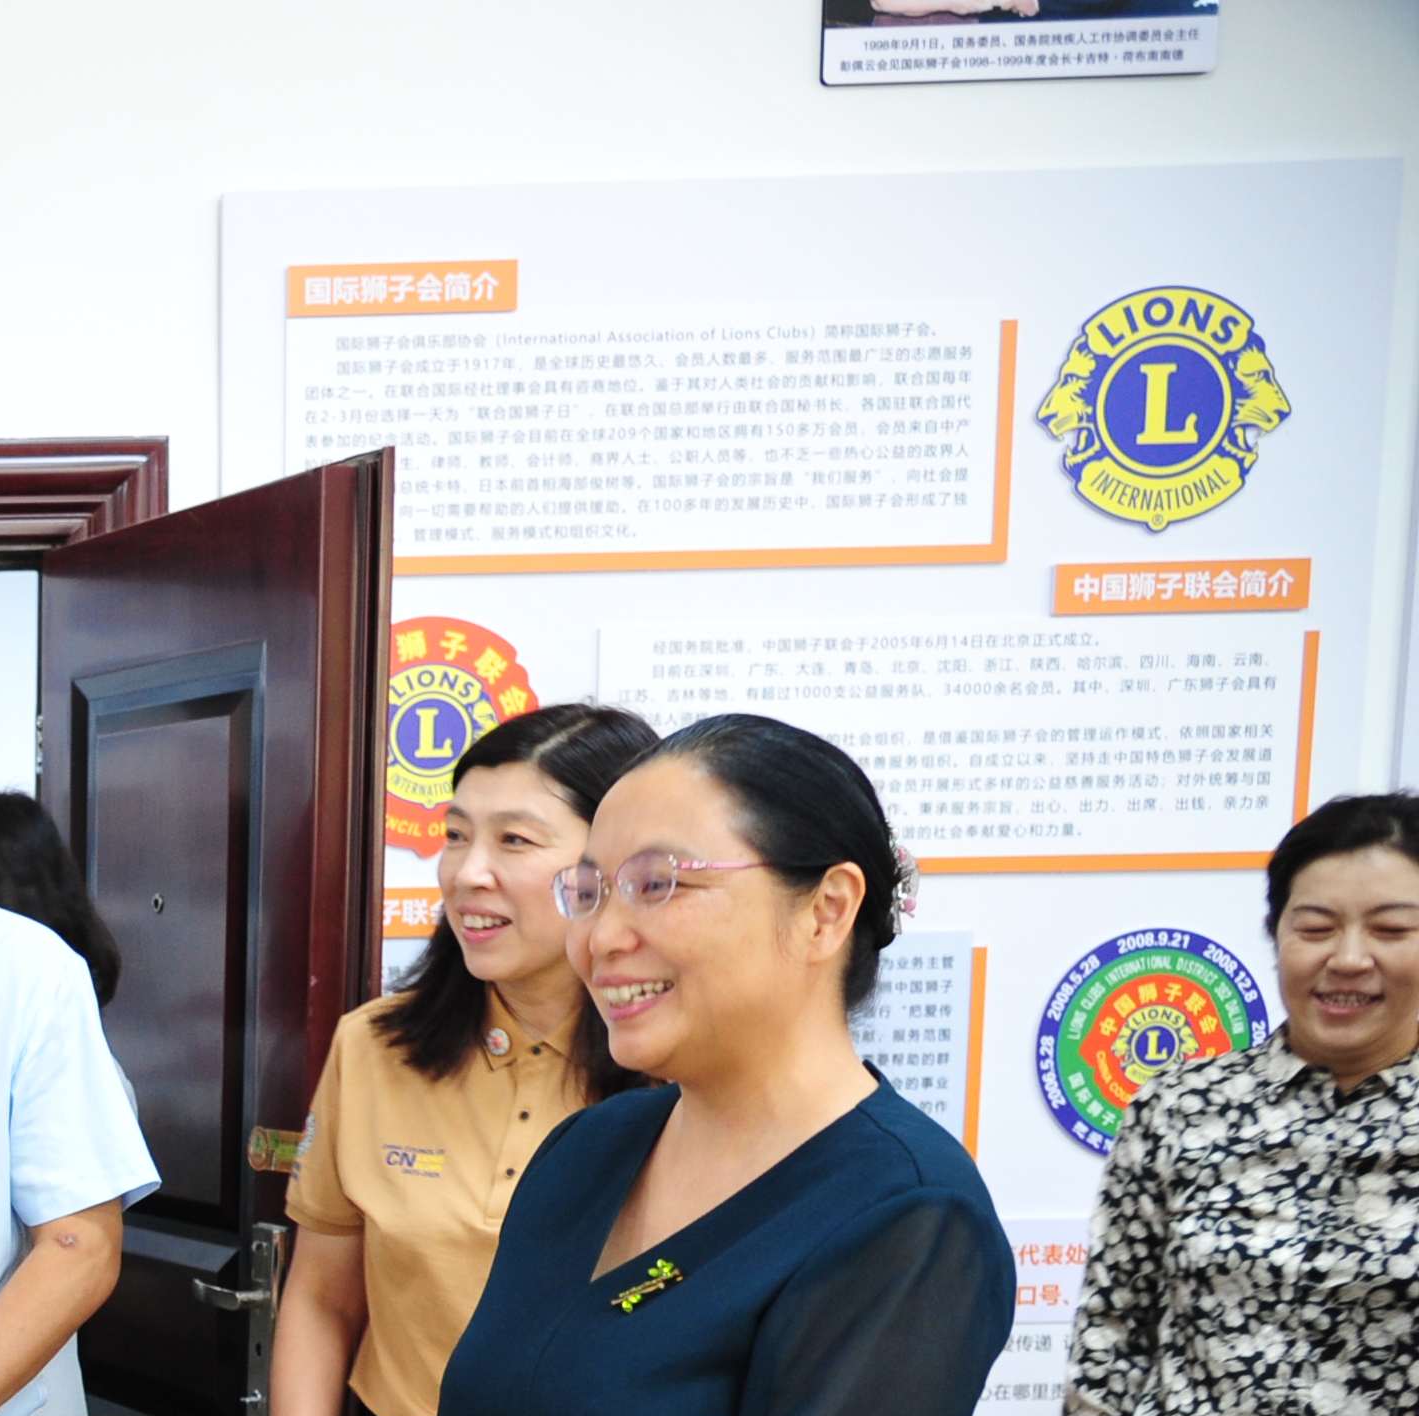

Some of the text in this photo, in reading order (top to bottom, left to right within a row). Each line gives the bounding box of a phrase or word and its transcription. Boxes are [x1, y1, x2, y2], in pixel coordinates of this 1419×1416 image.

[304, 271, 499, 305] 国际狮子会简介
[608, 327, 694, 344] Association
[701, 325, 717, 341] of
[722, 325, 761, 341] Lions
[1096, 296, 1241, 348] LIONS
[1136, 363, 1199, 445] L
[1090, 468, 1231, 511] INTERNATIONAL
[1072, 568, 1295, 603] 中国狮子联会简介
[391, 669, 476, 699] LIONS
[414, 707, 454, 758] L
[1117, 931, 1190, 954] 2008.9.21
[1047, 954, 1101, 1022] 2008.5.28
[1203, 943, 1259, 1004] 2008.12.8
[1133, 1008, 1183, 1027] LIONS
[1144, 1029, 1168, 1062] L
[1067, 1071, 1123, 1133] 国际狮子
[1016, 1243, 1087, 1266] 代表处
